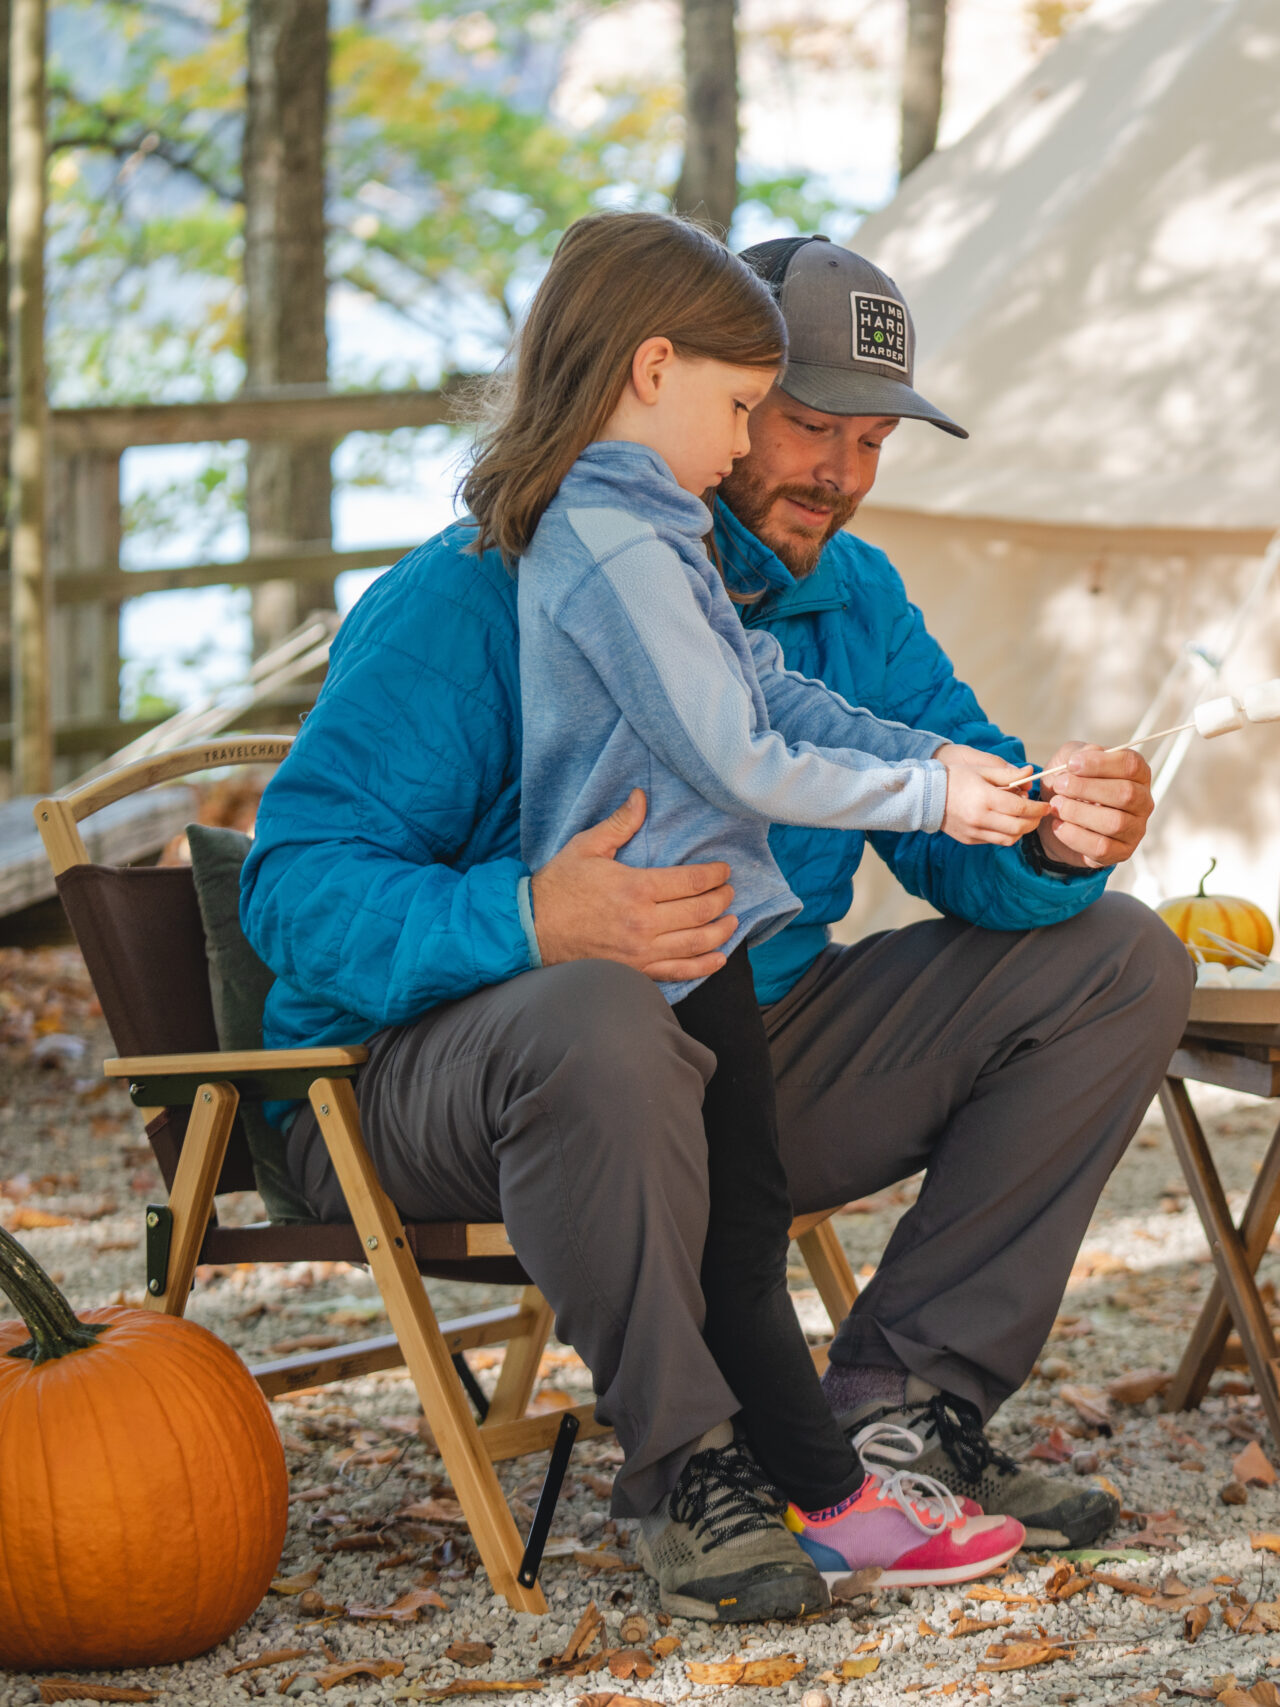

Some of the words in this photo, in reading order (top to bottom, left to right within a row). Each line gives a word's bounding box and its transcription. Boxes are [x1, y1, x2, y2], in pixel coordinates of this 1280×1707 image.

[860, 300, 903, 320] CLIMB
[861, 313, 904, 335] HARD
[861, 344, 904, 362] HARDER
[204, 743, 290, 762] TRAVELCHAIR
